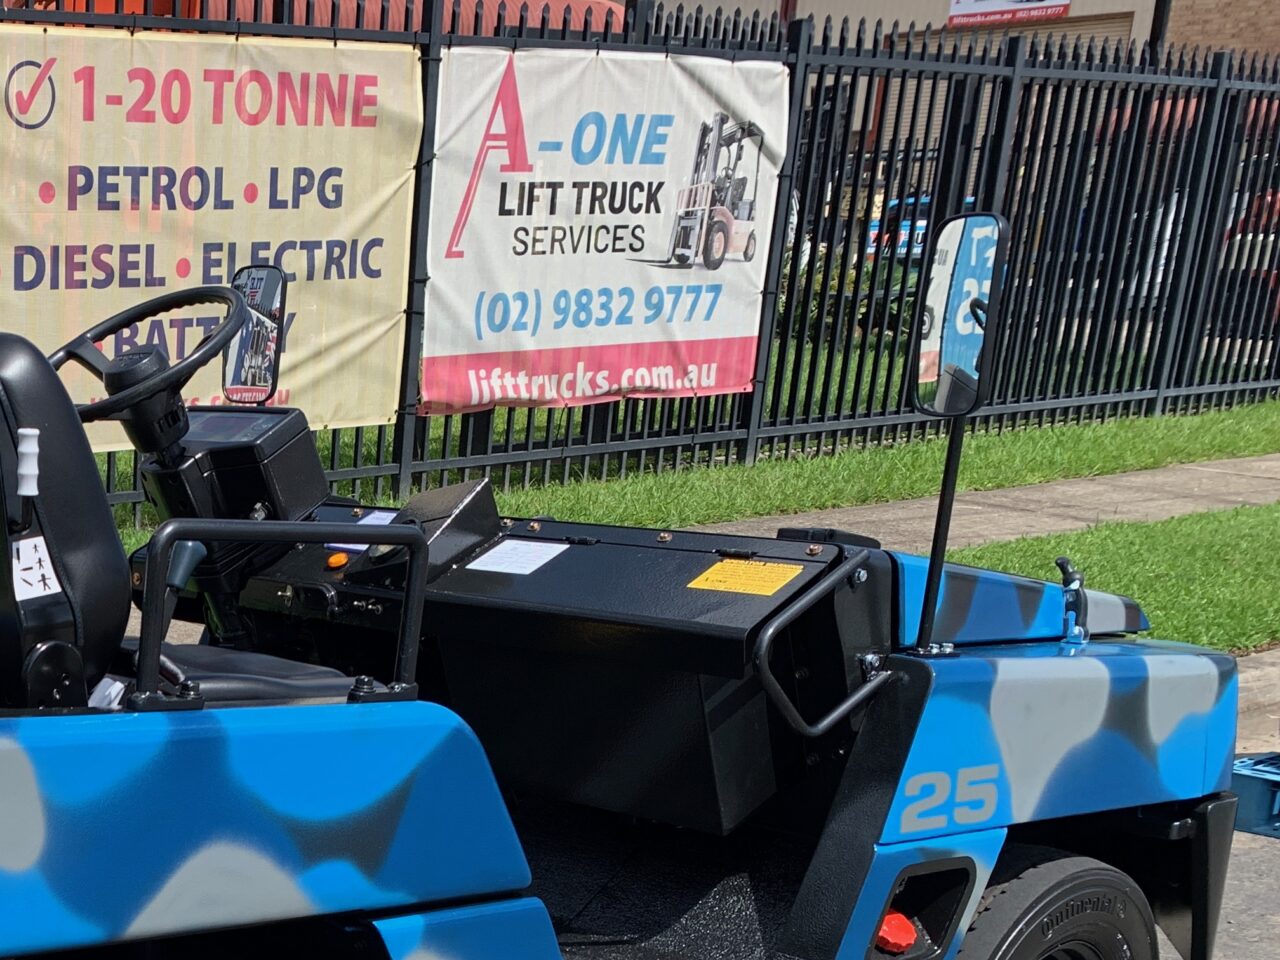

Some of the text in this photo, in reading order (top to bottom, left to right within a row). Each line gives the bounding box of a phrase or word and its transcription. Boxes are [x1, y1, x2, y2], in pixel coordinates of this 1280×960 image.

[73, 64, 379, 128] 1-20 TONNE
[67, 165, 345, 211] PETROL LPG
[498, 181, 665, 217] LIFT TRUCK
[512, 224, 646, 257] SERVICES
[13, 243, 166, 291] DIESEL
[114, 312, 297, 361] BATTY
[474, 284, 723, 341] (02) 9832 9777
[467, 360, 718, 406] lifttrucks.com.au
[900, 765, 1000, 834] 25
